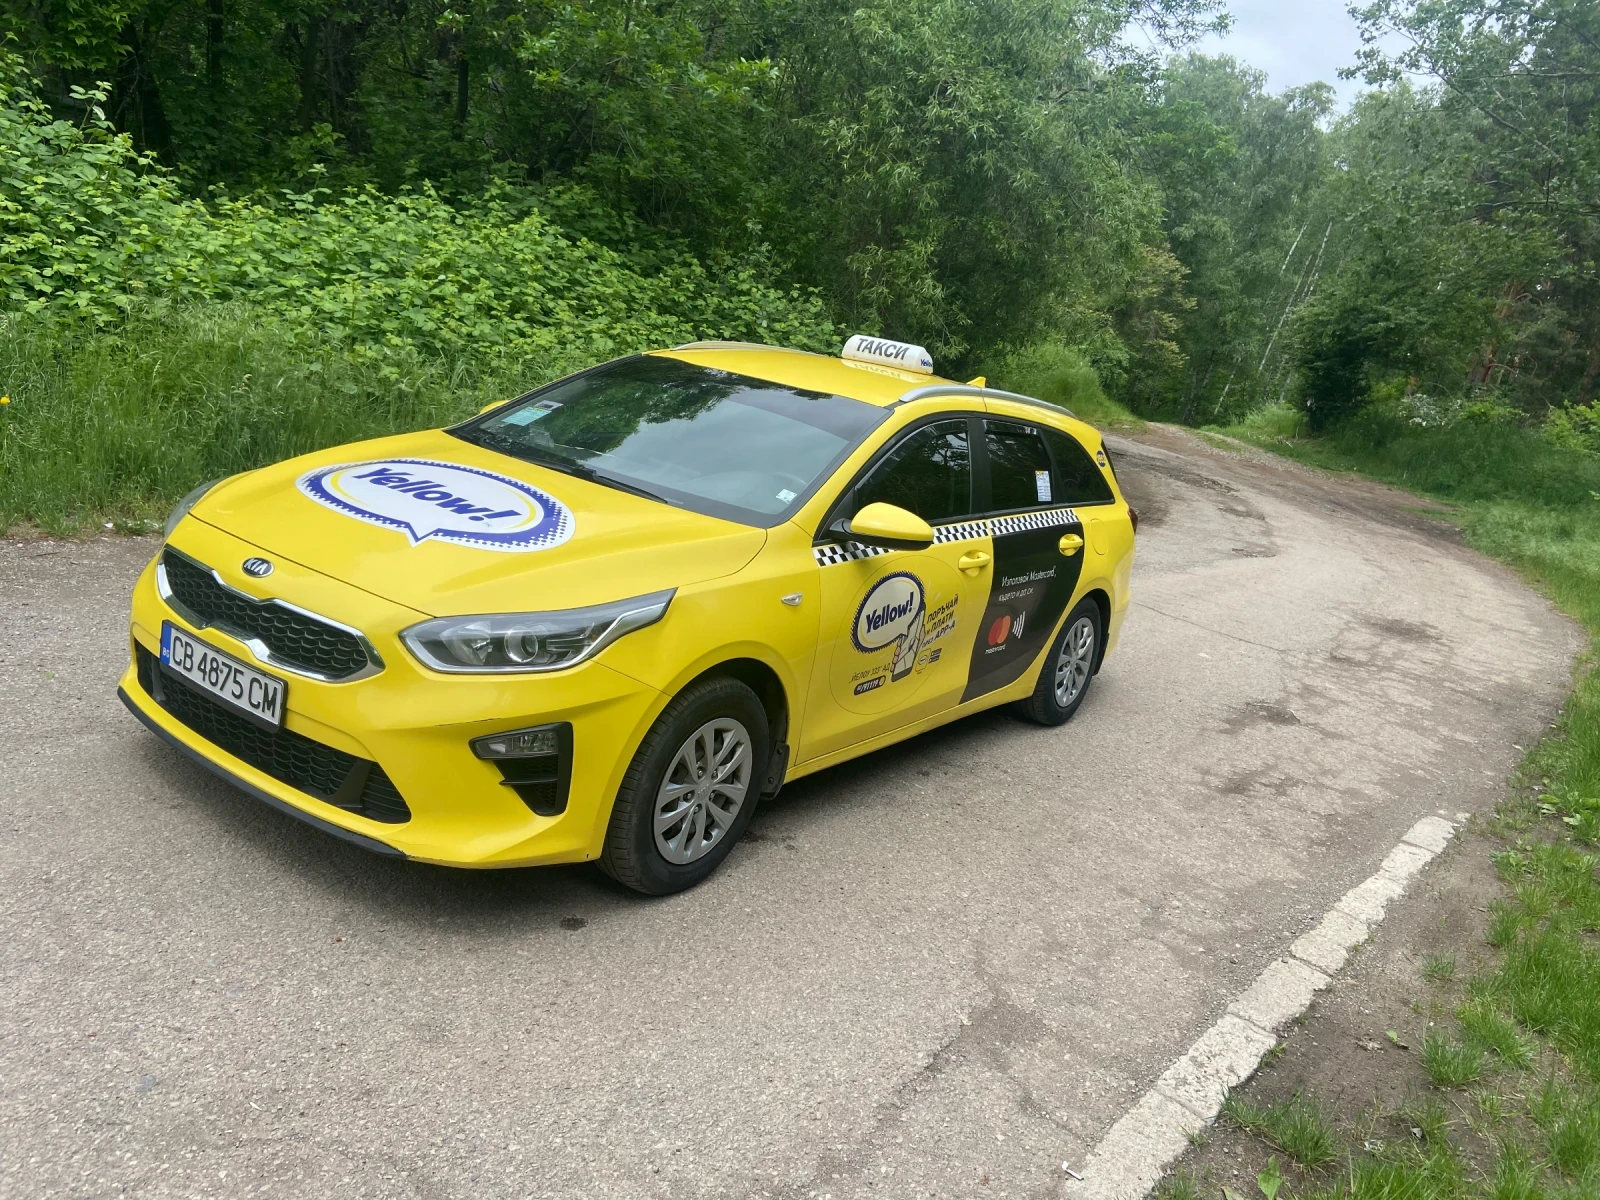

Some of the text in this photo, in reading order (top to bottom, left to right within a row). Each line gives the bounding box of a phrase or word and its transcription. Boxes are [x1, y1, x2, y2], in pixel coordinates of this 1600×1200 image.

[856, 338, 909, 360] ТАКСИ
[352, 467, 522, 522] Yellow!
[244, 558, 268, 575] KIA
[866, 591, 914, 634] Yellow!
[926, 593, 959, 624] ПОРЪЧАЙ
[930, 609, 955, 633] ПЛАТИ
[162, 647, 170, 658] BG
[172, 635, 278, 718] CB 4875 CM
